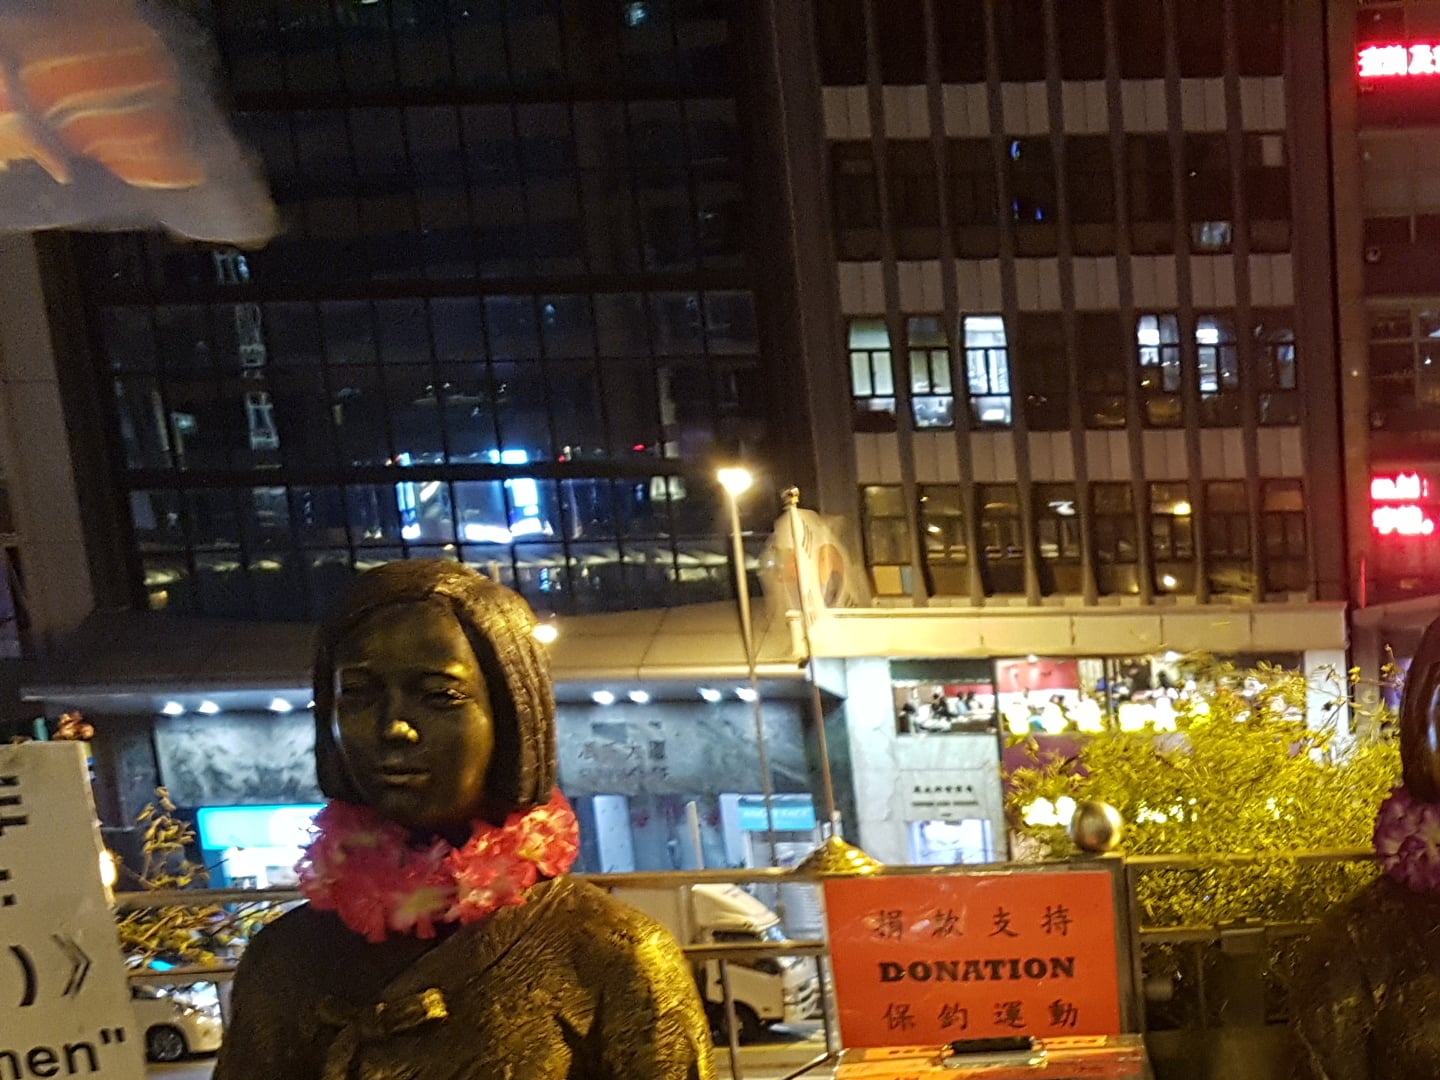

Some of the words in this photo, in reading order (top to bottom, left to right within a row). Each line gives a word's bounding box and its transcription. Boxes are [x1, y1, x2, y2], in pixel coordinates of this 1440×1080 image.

[874, 904, 1073, 940] 捐款支持
[879, 956, 1075, 982] DONATION
[882, 998, 1079, 1031] 保釣運動
